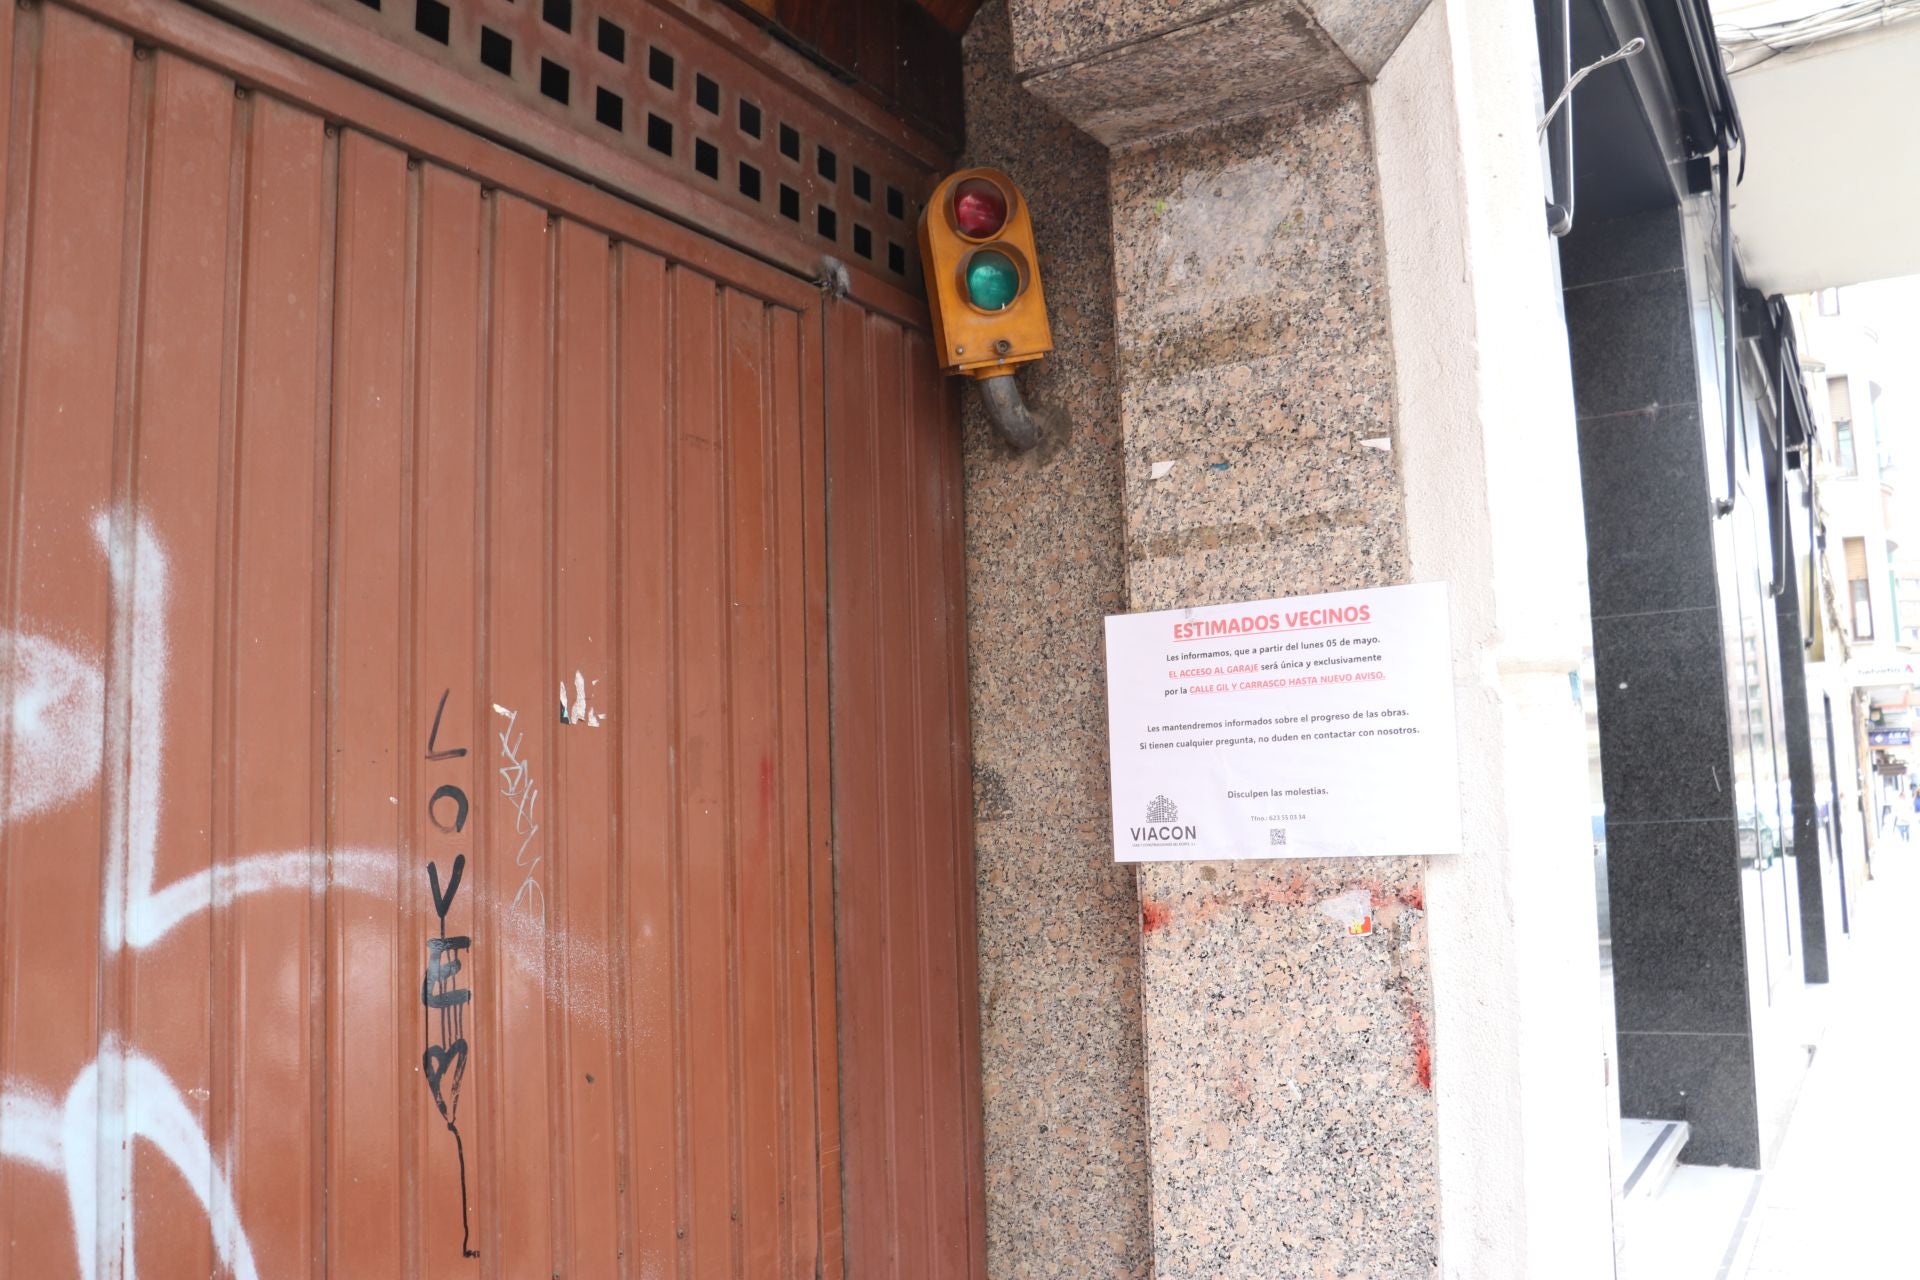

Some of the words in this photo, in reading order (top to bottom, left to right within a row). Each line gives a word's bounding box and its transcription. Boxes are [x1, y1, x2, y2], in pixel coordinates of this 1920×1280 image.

[1173, 614, 1280, 639] ESTIMADOS
[1285, 605, 1371, 628] VECINOS
[1166, 654, 1180, 662] Les
[1181, 650, 1232, 661] informamos,
[1234, 648, 1250, 657] que
[1259, 644, 1283, 654] partir
[1285, 642, 1299, 651] del
[1301, 641, 1324, 650] lunes
[1326, 639, 1337, 647] 05
[1340, 638, 1350, 646] de
[1353, 637, 1380, 647] mayo.
[1168, 670, 1178, 678] EL
[1180, 667, 1212, 678] ACCESO
[1214, 666, 1225, 675] AL
[1226, 664, 1259, 674] GARAJE
[1260, 661, 1278, 670] será
[1281, 660, 1303, 669] única
[1306, 661, 1311, 669] y
[1313, 654, 1382, 667] exclusivamente
[1164, 689, 1178, 697] por
[1180, 687, 1188, 695] la
[1189, 684, 1214, 694] CALLE
[1216, 683, 1229, 692] GIL
[1232, 682, 1237, 690] Y
[1239, 678, 1286, 690] CARRASCO
[1288, 676, 1318, 686] HASTA
[1320, 673, 1352, 683] NUEVO
[1355, 671, 1386, 681] AVISO.
[1147, 725, 1160, 733] Les
[1162, 721, 1223, 732] mantendremos
[1224, 717, 1272, 728] informados
[1274, 716, 1298, 724] sobre
[1300, 714, 1308, 722] el
[1311, 713, 1350, 724] progreso
[1352, 710, 1363, 719] de
[1366, 710, 1378, 718] las
[1381, 709, 1409, 717] obras.
[1139, 742, 1146, 750] Si
[1149, 741, 1174, 750] tienen
[1176, 738, 1213, 748] cualquier
[1215, 736, 1256, 747] pregunta,
[1271, 734, 1298, 742] duden
[1314, 730, 1356, 740] contactar
[1358, 729, 1374, 737] con
[1377, 726, 1420, 736] nosotros.
[1227, 789, 1268, 799] Disculpen
[1270, 789, 1283, 797] las
[1285, 787, 1328, 796] molestias.
[1130, 825, 1197, 842] VIACON
